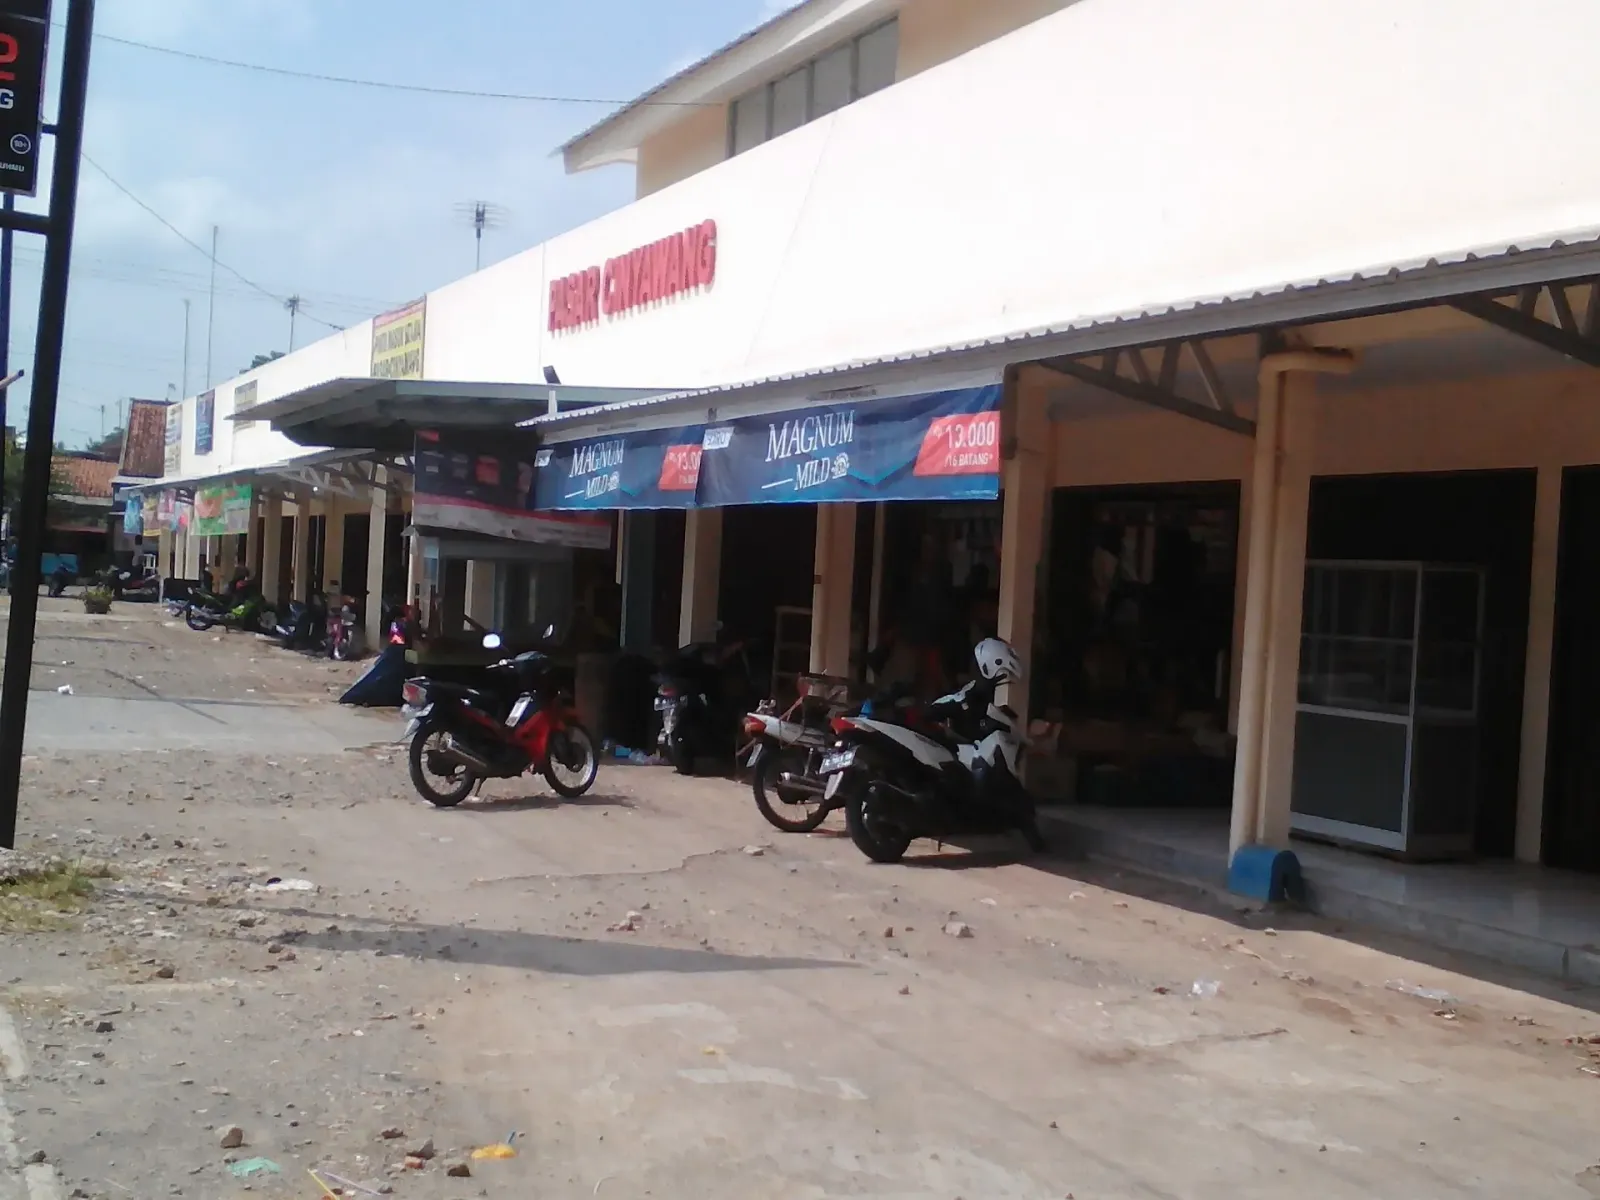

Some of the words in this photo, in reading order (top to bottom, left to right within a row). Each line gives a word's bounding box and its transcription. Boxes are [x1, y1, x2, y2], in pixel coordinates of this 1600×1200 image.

[765, 410, 855, 462] MAGNUM
[945, 420, 996, 449] 13.000
[569, 439, 626, 478] MAGNUM
[794, 457, 830, 492] MILD
[585, 474, 607, 500] MILD
